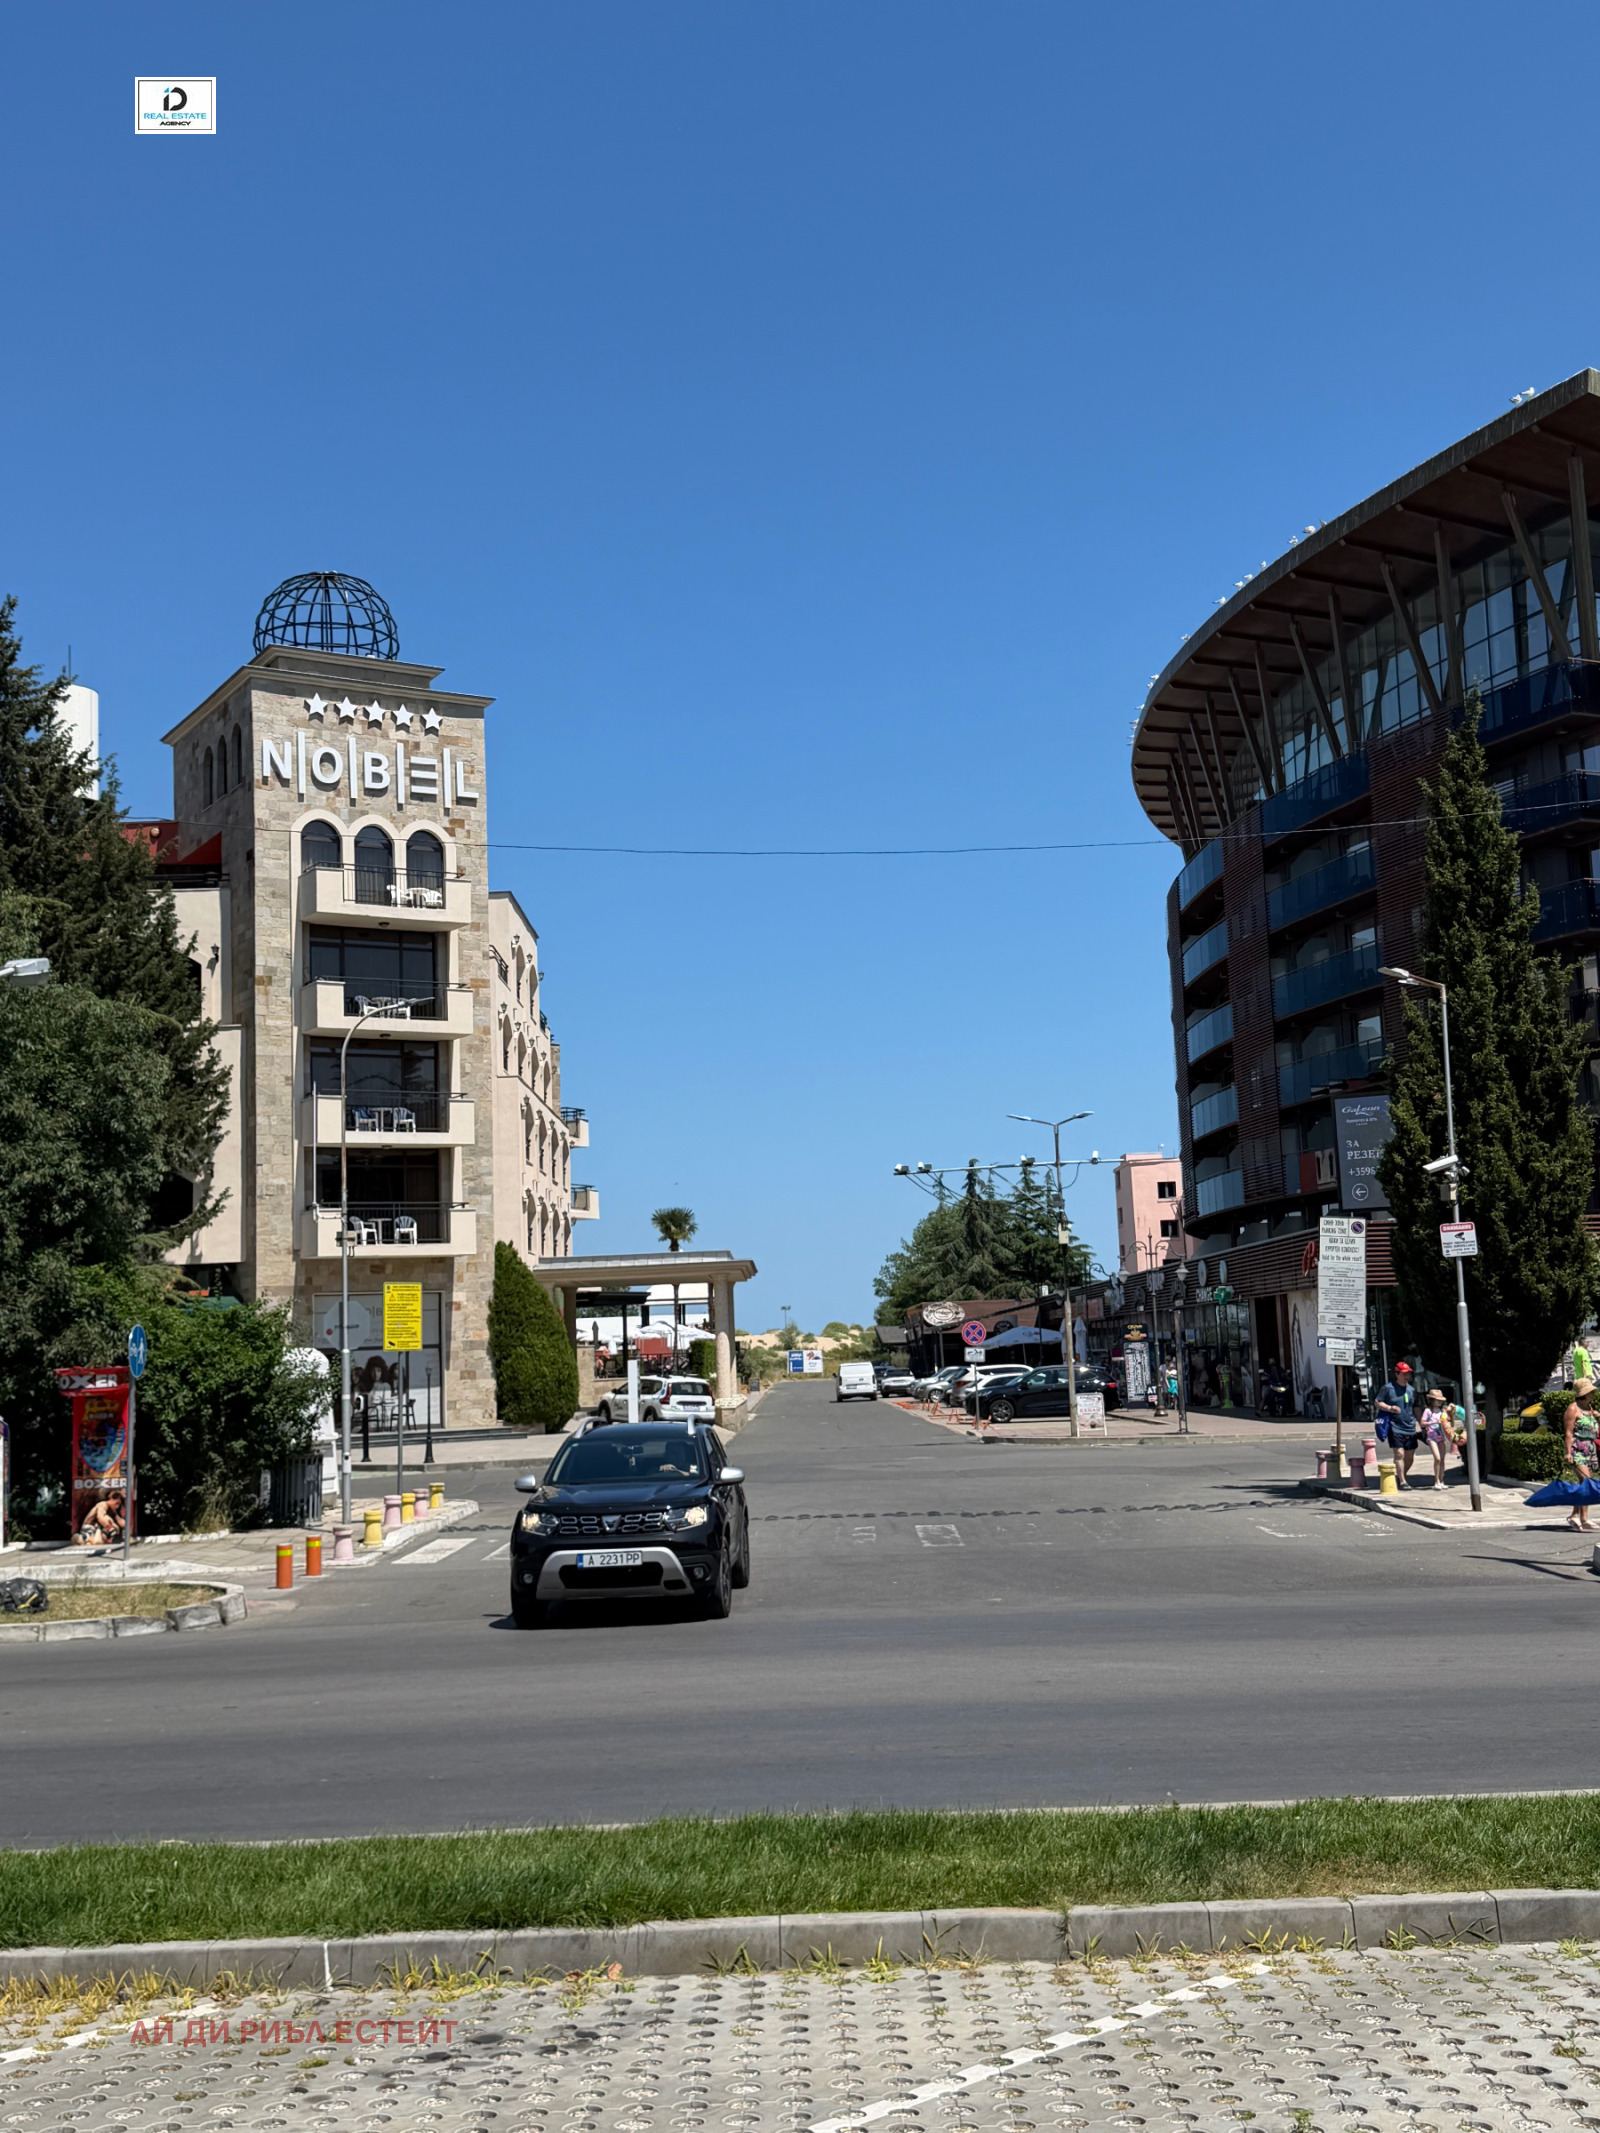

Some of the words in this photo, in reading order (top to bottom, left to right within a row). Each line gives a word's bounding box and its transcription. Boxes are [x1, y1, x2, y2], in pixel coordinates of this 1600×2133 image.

[262, 732, 479, 808] NOBEL
[1348, 1166, 1379, 1176] +3598
[59, 1374, 117, 1389] OXER
[74, 1478, 127, 1489] BOXER
[588, 1555, 595, 1565] A
